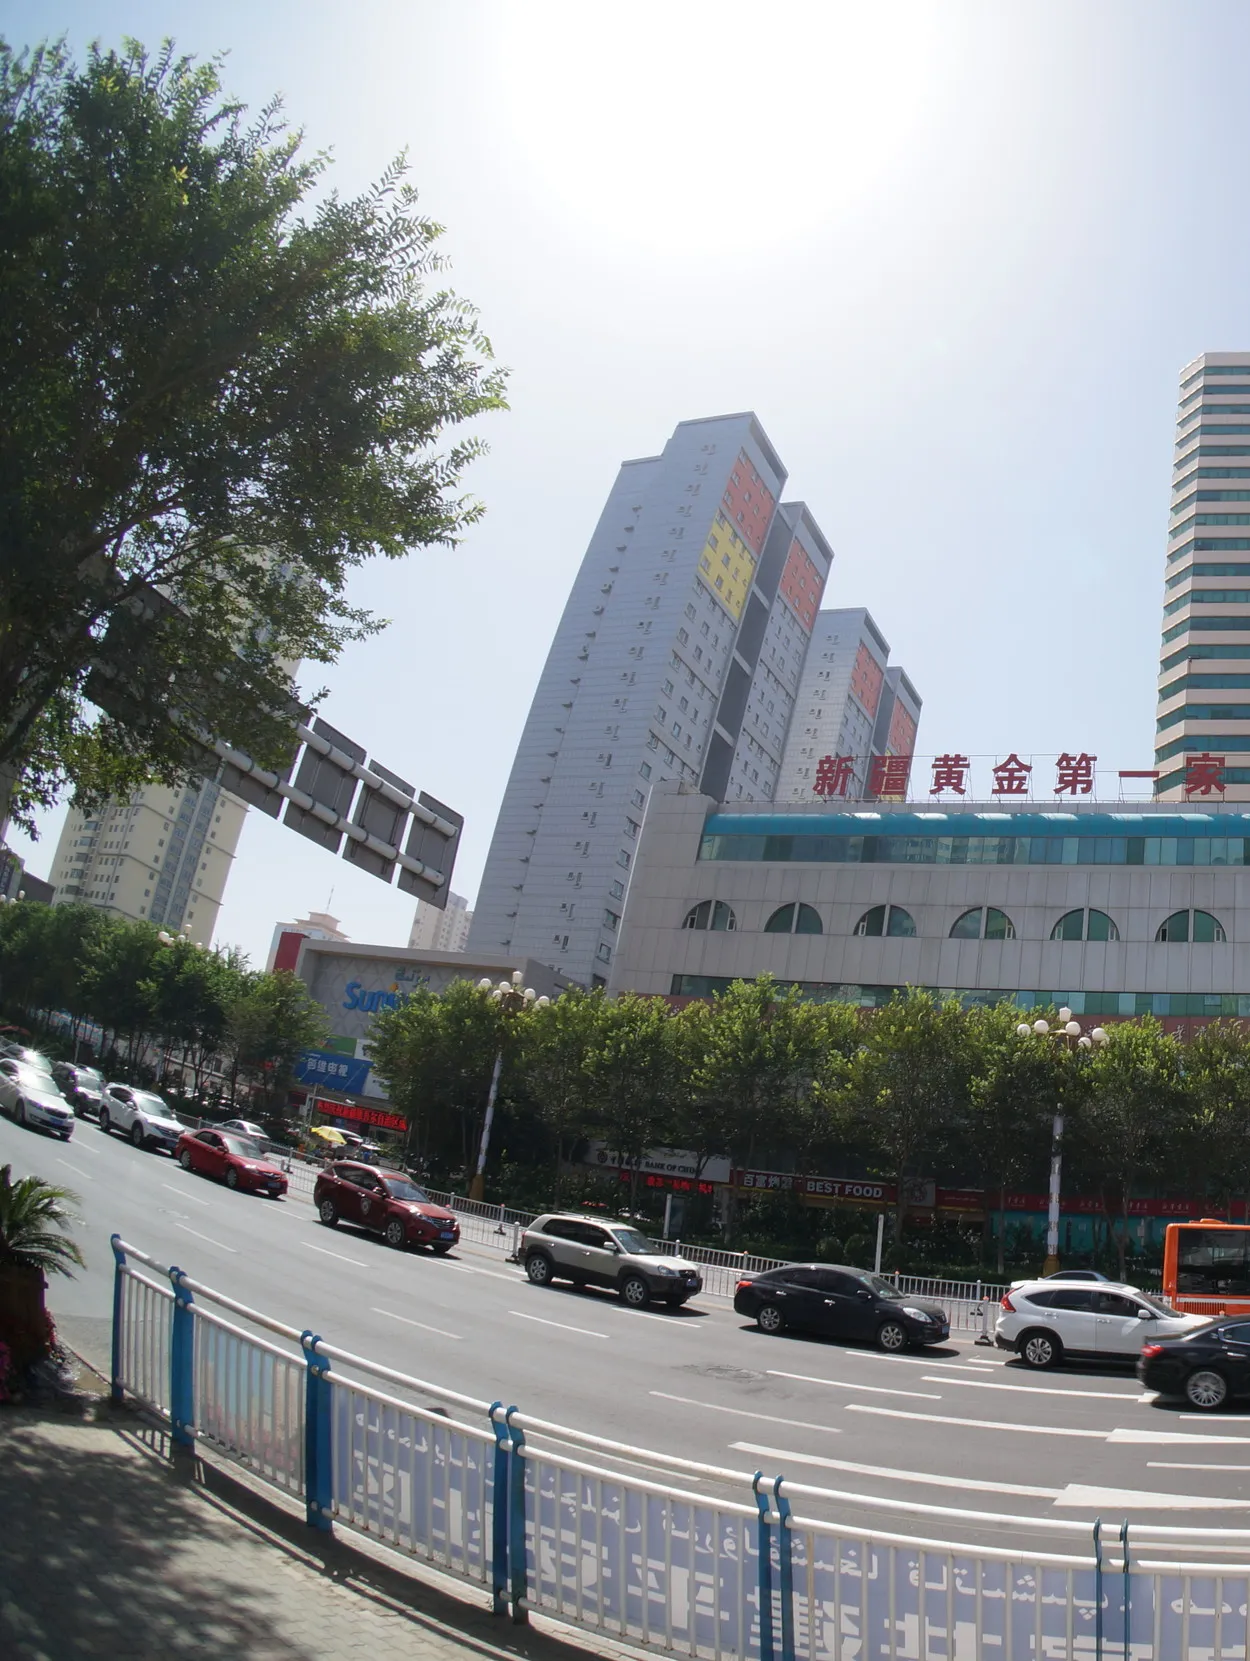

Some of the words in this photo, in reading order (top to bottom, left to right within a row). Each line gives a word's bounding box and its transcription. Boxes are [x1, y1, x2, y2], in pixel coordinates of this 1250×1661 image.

[813, 753, 1227, 796] 新疆黄金第一家
[645, 1161, 665, 1171] BANK
[667, 1163, 677, 1172] OF
[806, 1181, 842, 1195] BEST
[845, 1184, 883, 1199] FOOD
